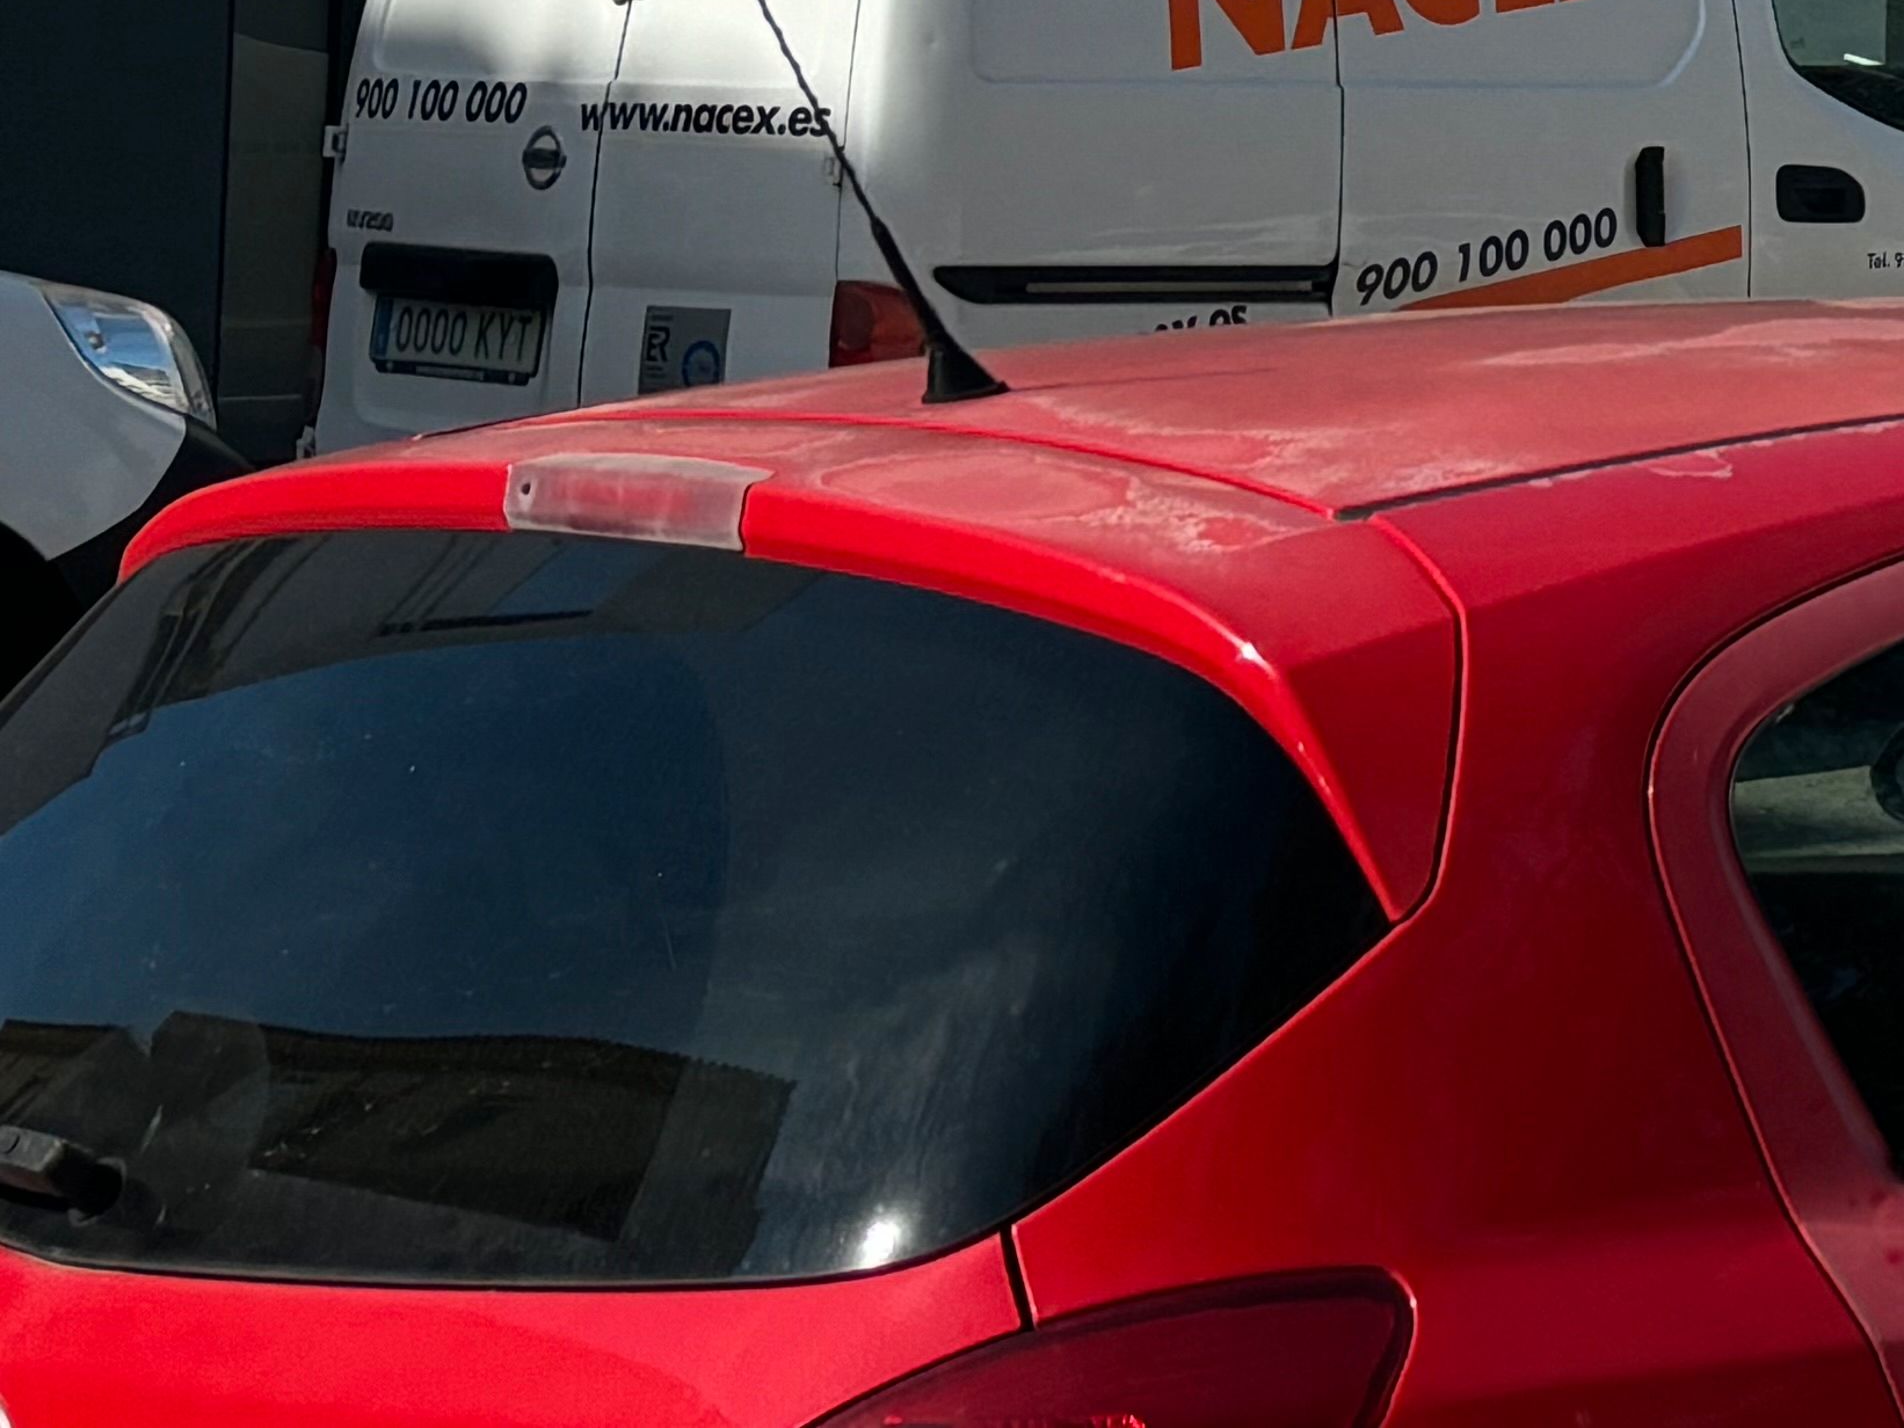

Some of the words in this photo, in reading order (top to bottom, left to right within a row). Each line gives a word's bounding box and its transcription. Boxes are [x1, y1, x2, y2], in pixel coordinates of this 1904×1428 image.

[356, 78, 399, 119] 900
[408, 80, 459, 121] 100
[465, 81, 527, 124] 000
[581, 101, 832, 137] www.nacex.es
[1356, 251, 1437, 306] 900
[1458, 229, 1529, 282] 100
[1544, 207, 1617, 261] 000
[396, 306, 468, 356] 0000
[474, 311, 534, 362] KYT
